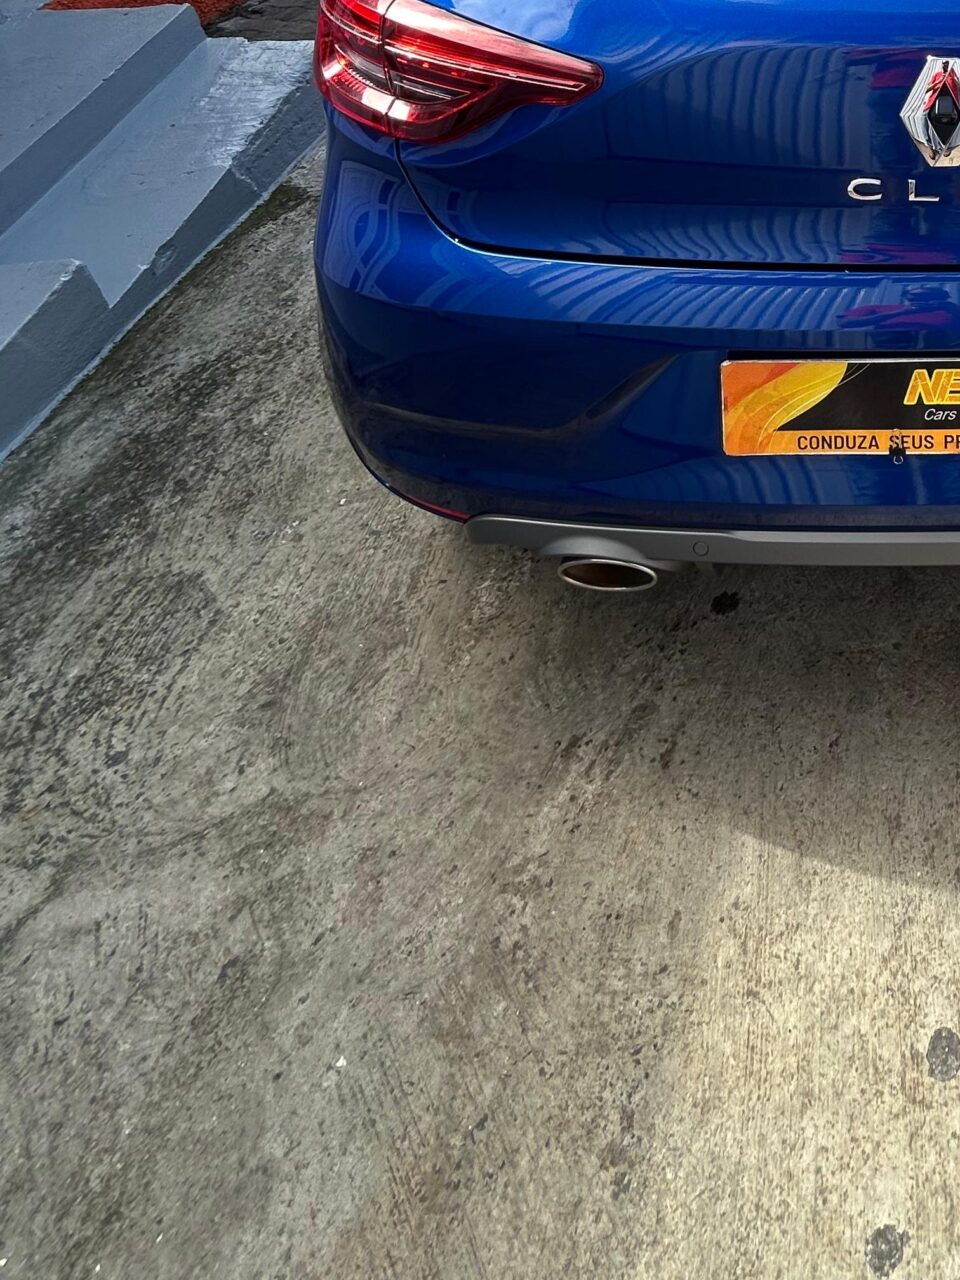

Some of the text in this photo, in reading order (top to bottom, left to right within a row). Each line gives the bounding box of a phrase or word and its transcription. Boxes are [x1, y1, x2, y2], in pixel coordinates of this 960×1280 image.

[924, 408, 957, 421] Cars
[797, 435, 879, 450] CONDUZA
[889, 434, 934, 449] SEUS
